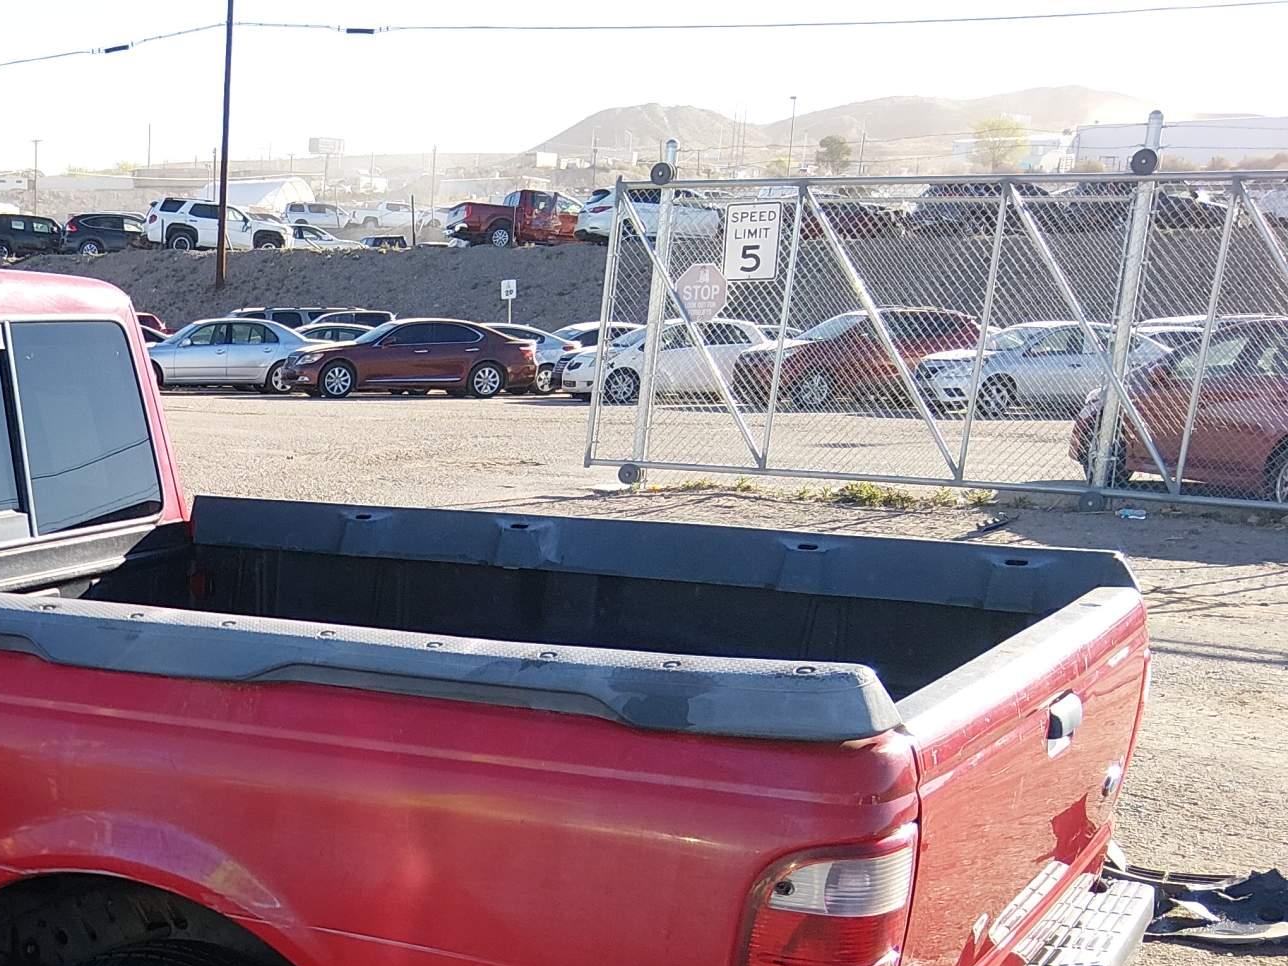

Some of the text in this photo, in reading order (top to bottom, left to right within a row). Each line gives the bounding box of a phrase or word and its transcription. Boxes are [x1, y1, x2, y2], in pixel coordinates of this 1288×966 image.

[731, 210, 777, 223] SPEED
[735, 227, 771, 240] LIMIT
[740, 245, 761, 272] 5
[683, 284, 720, 301] STOP
